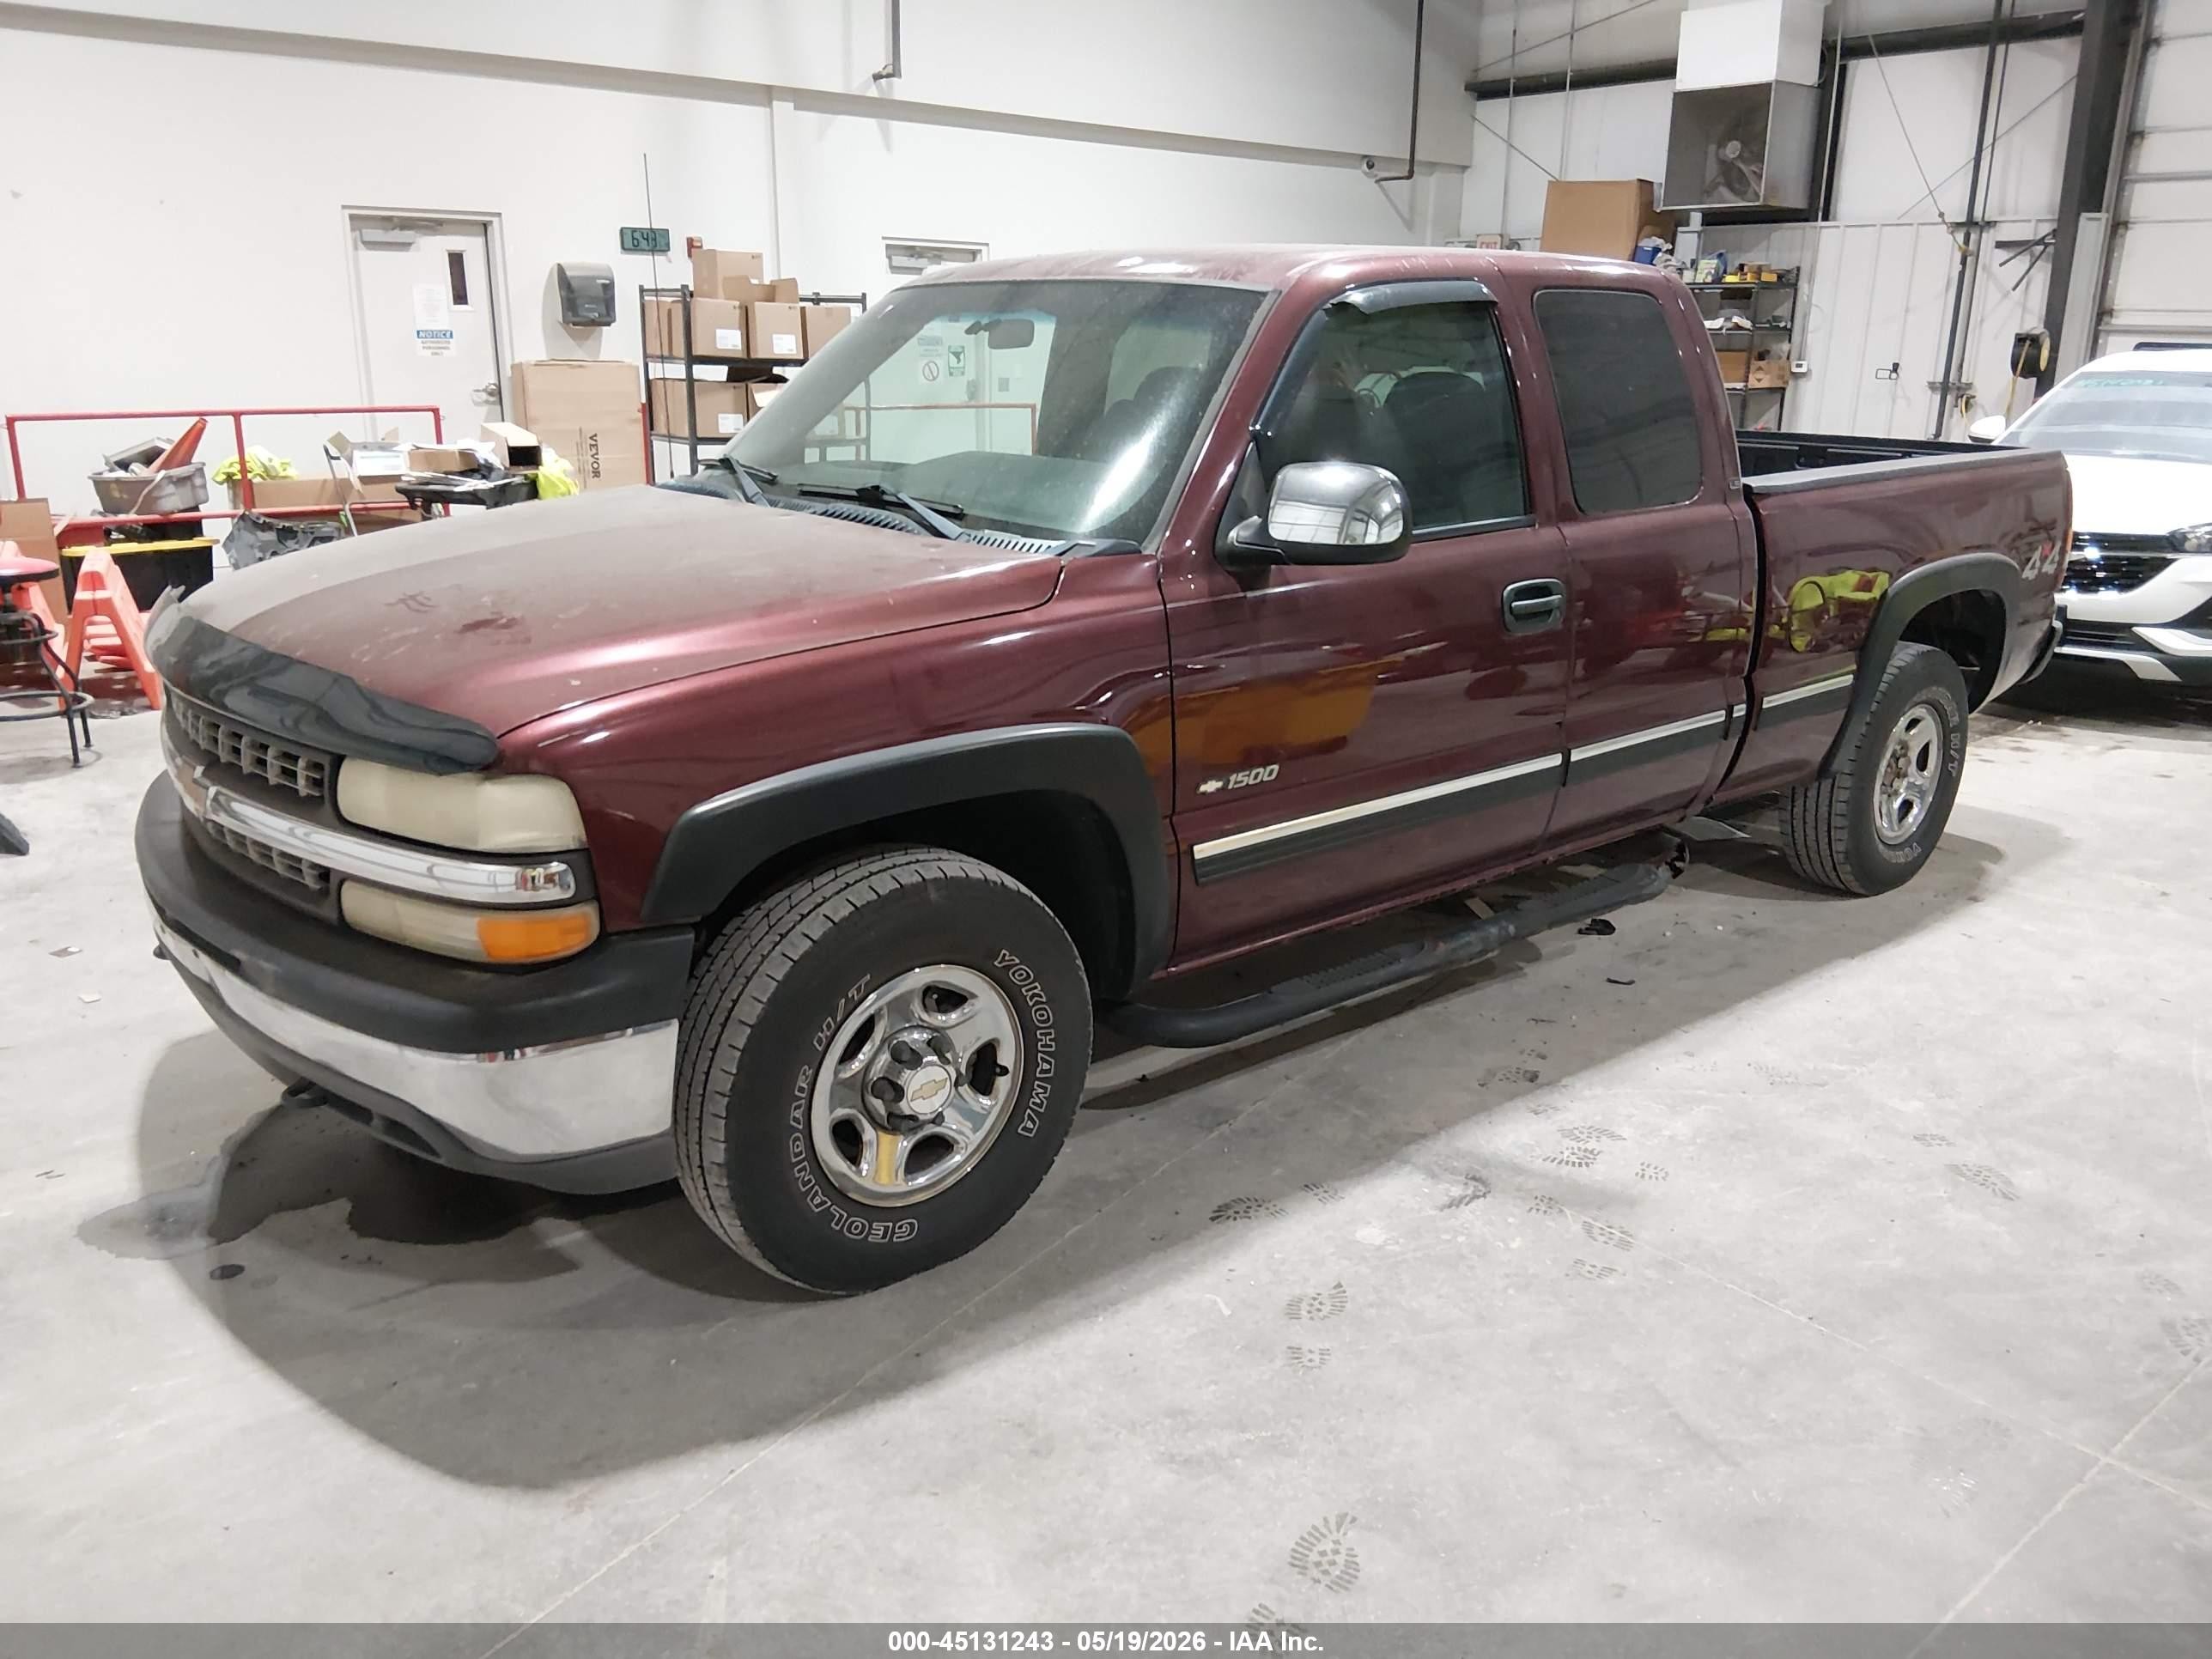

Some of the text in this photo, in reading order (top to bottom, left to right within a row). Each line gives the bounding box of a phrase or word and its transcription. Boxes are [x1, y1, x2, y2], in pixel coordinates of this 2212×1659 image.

[588, 433, 601, 478] VEVOR
[1228, 764, 1280, 789] 1500
[994, 949, 1056, 1137] YOKOHAMA
[789, 973, 918, 1243] GEOLANDAR H/T
